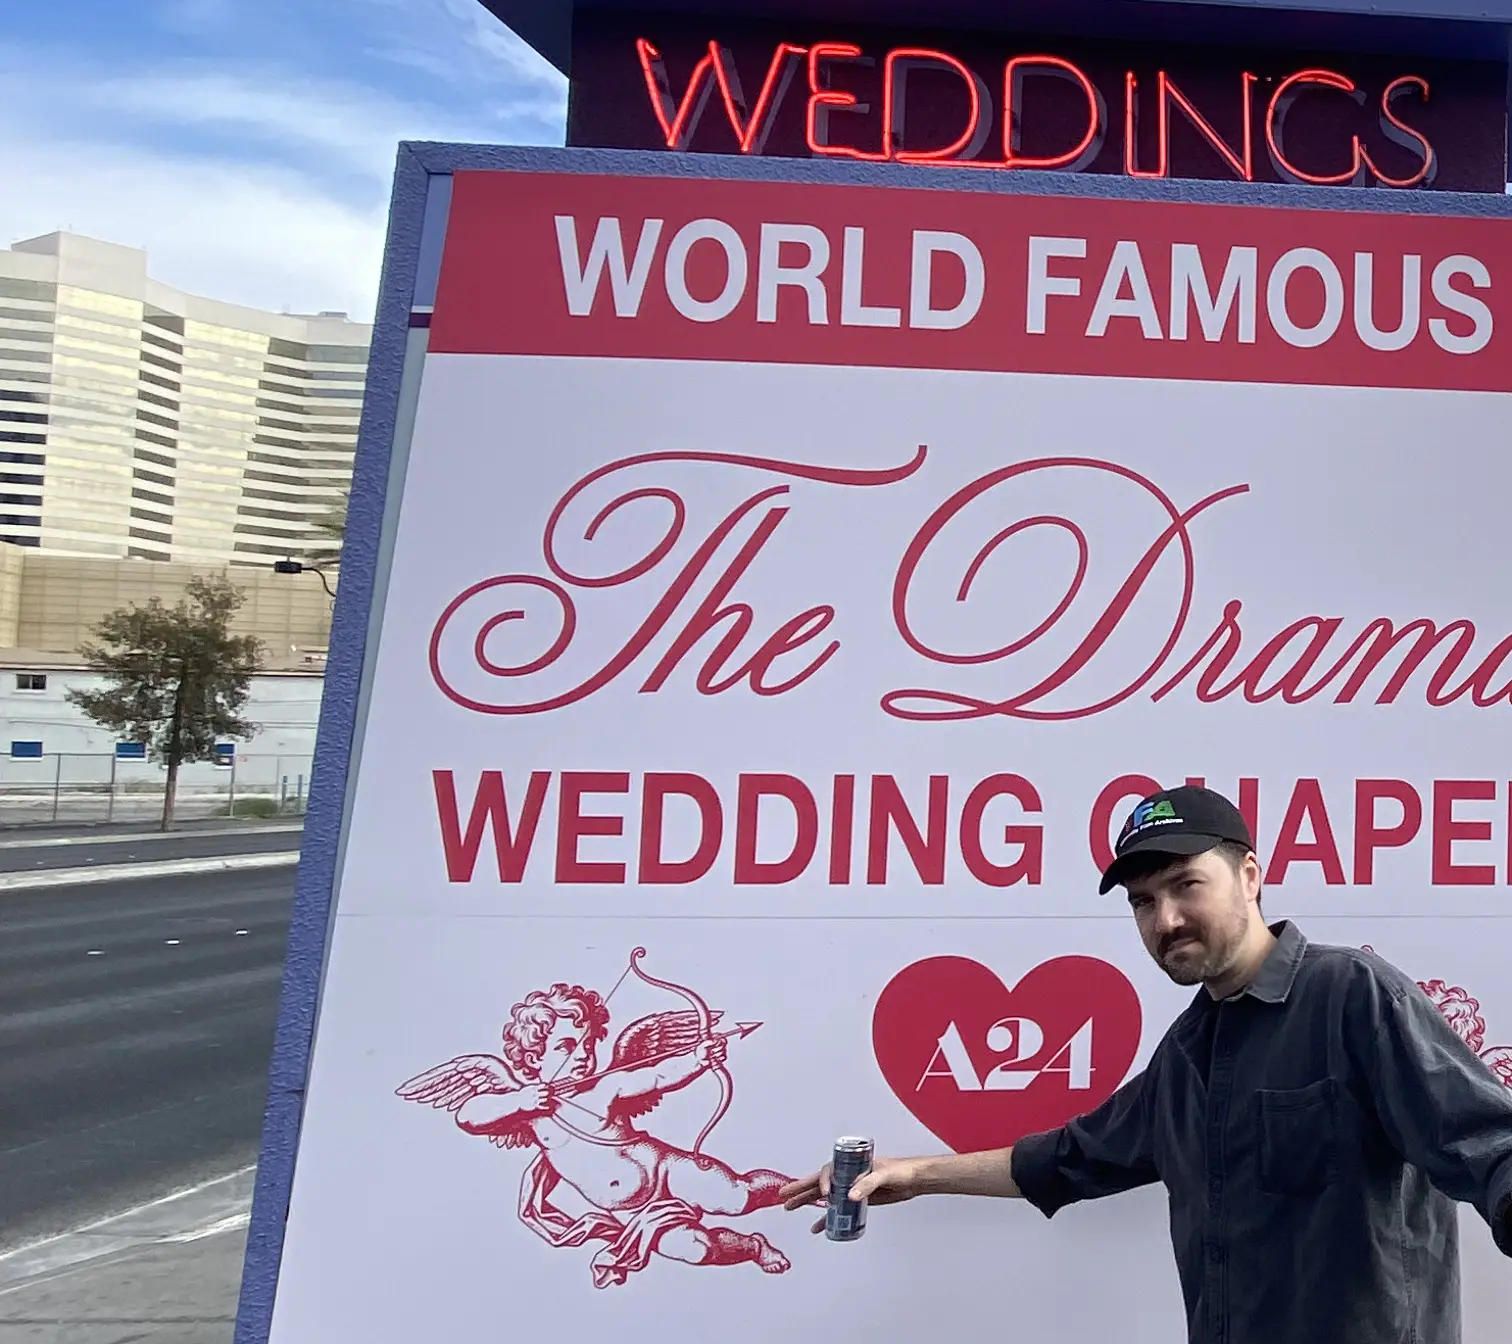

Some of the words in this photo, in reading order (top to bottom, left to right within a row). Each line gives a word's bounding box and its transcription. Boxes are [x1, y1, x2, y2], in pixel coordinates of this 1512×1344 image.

[637, 38, 1434, 187] WEDDINGS
[555, 216, 985, 330] WORLD
[1026, 236, 1494, 354] FAMOUS
[429, 445, 928, 716] The
[432, 769, 1044, 888] WEDDING
[915, 1017, 1097, 1092] A24
